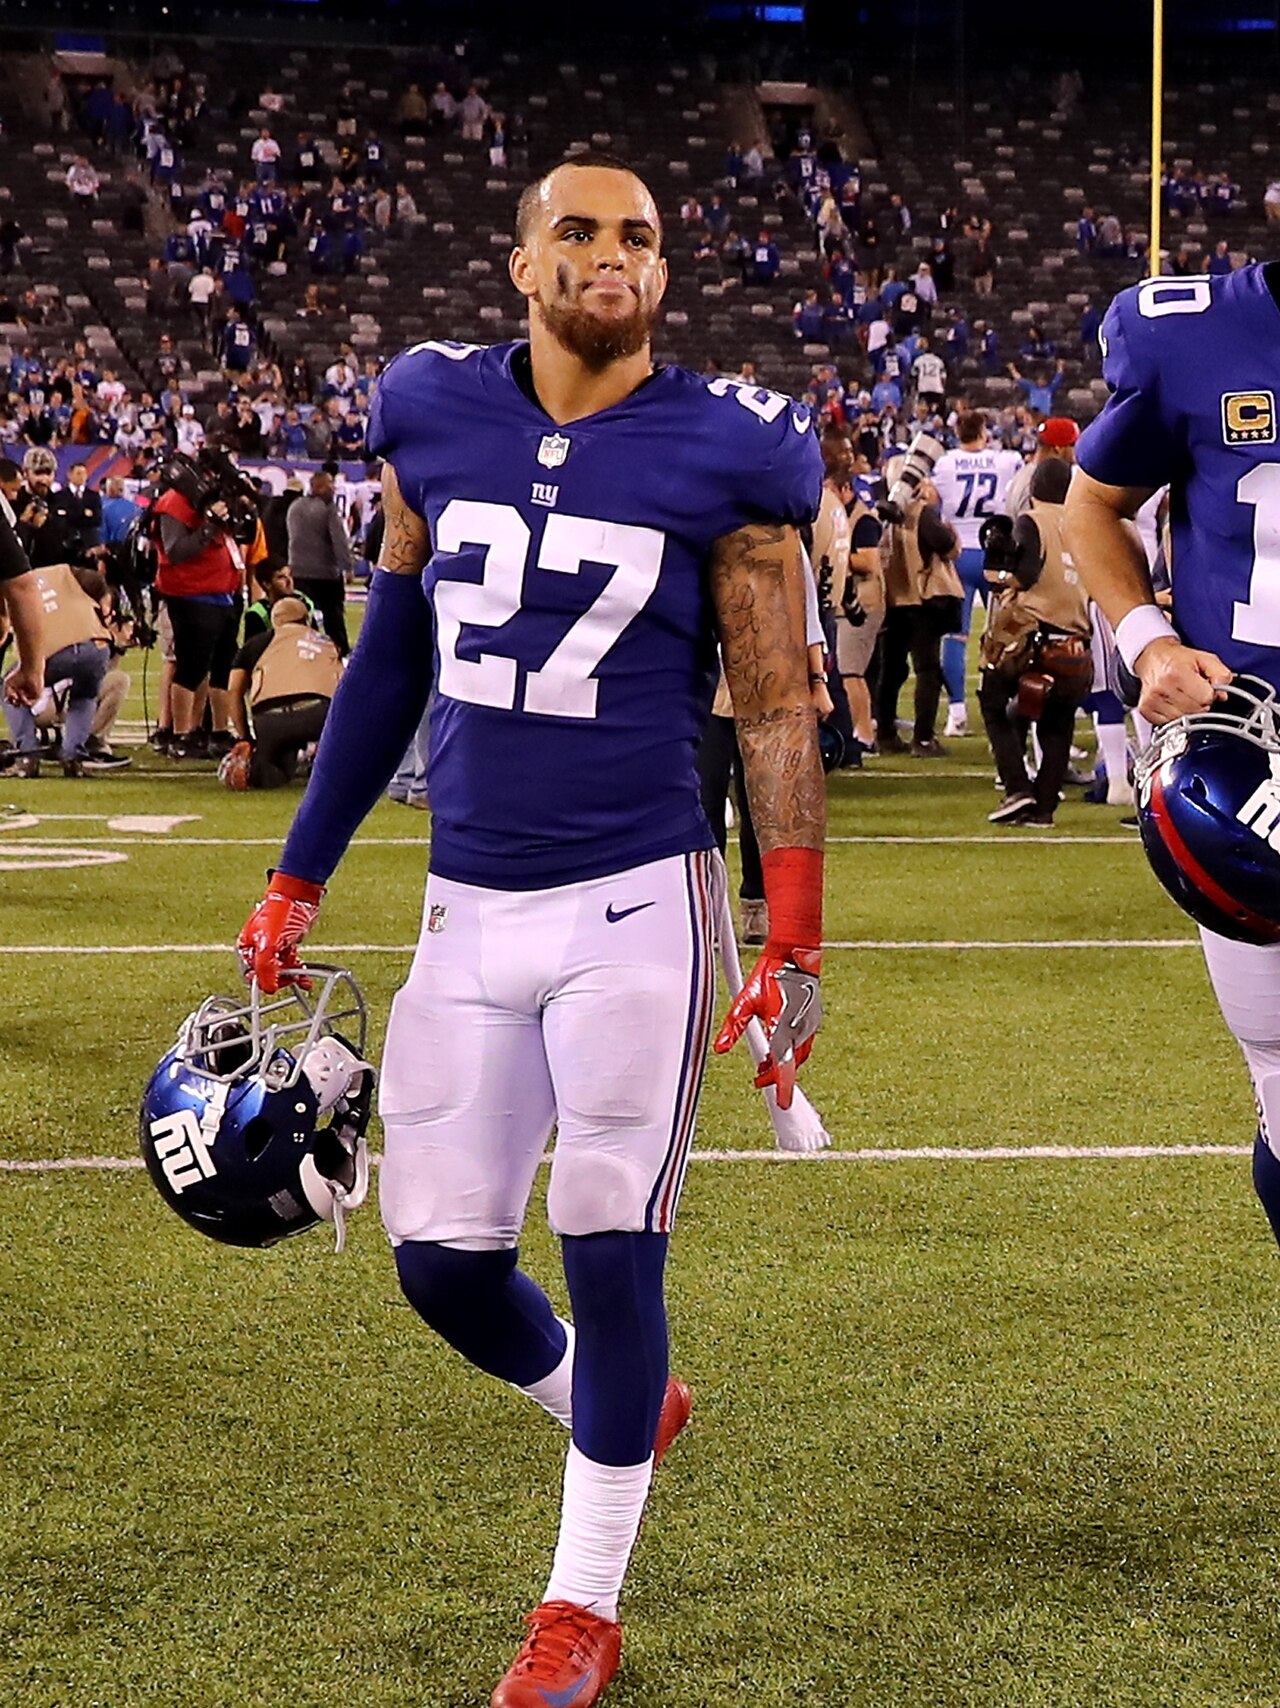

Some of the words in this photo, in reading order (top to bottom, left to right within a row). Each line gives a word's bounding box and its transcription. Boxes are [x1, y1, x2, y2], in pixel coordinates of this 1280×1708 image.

[922, 362, 938, 377] 12
[1227, 395, 1270, 431] C
[955, 473, 998, 517] 72
[435, 500, 665, 718] 27
